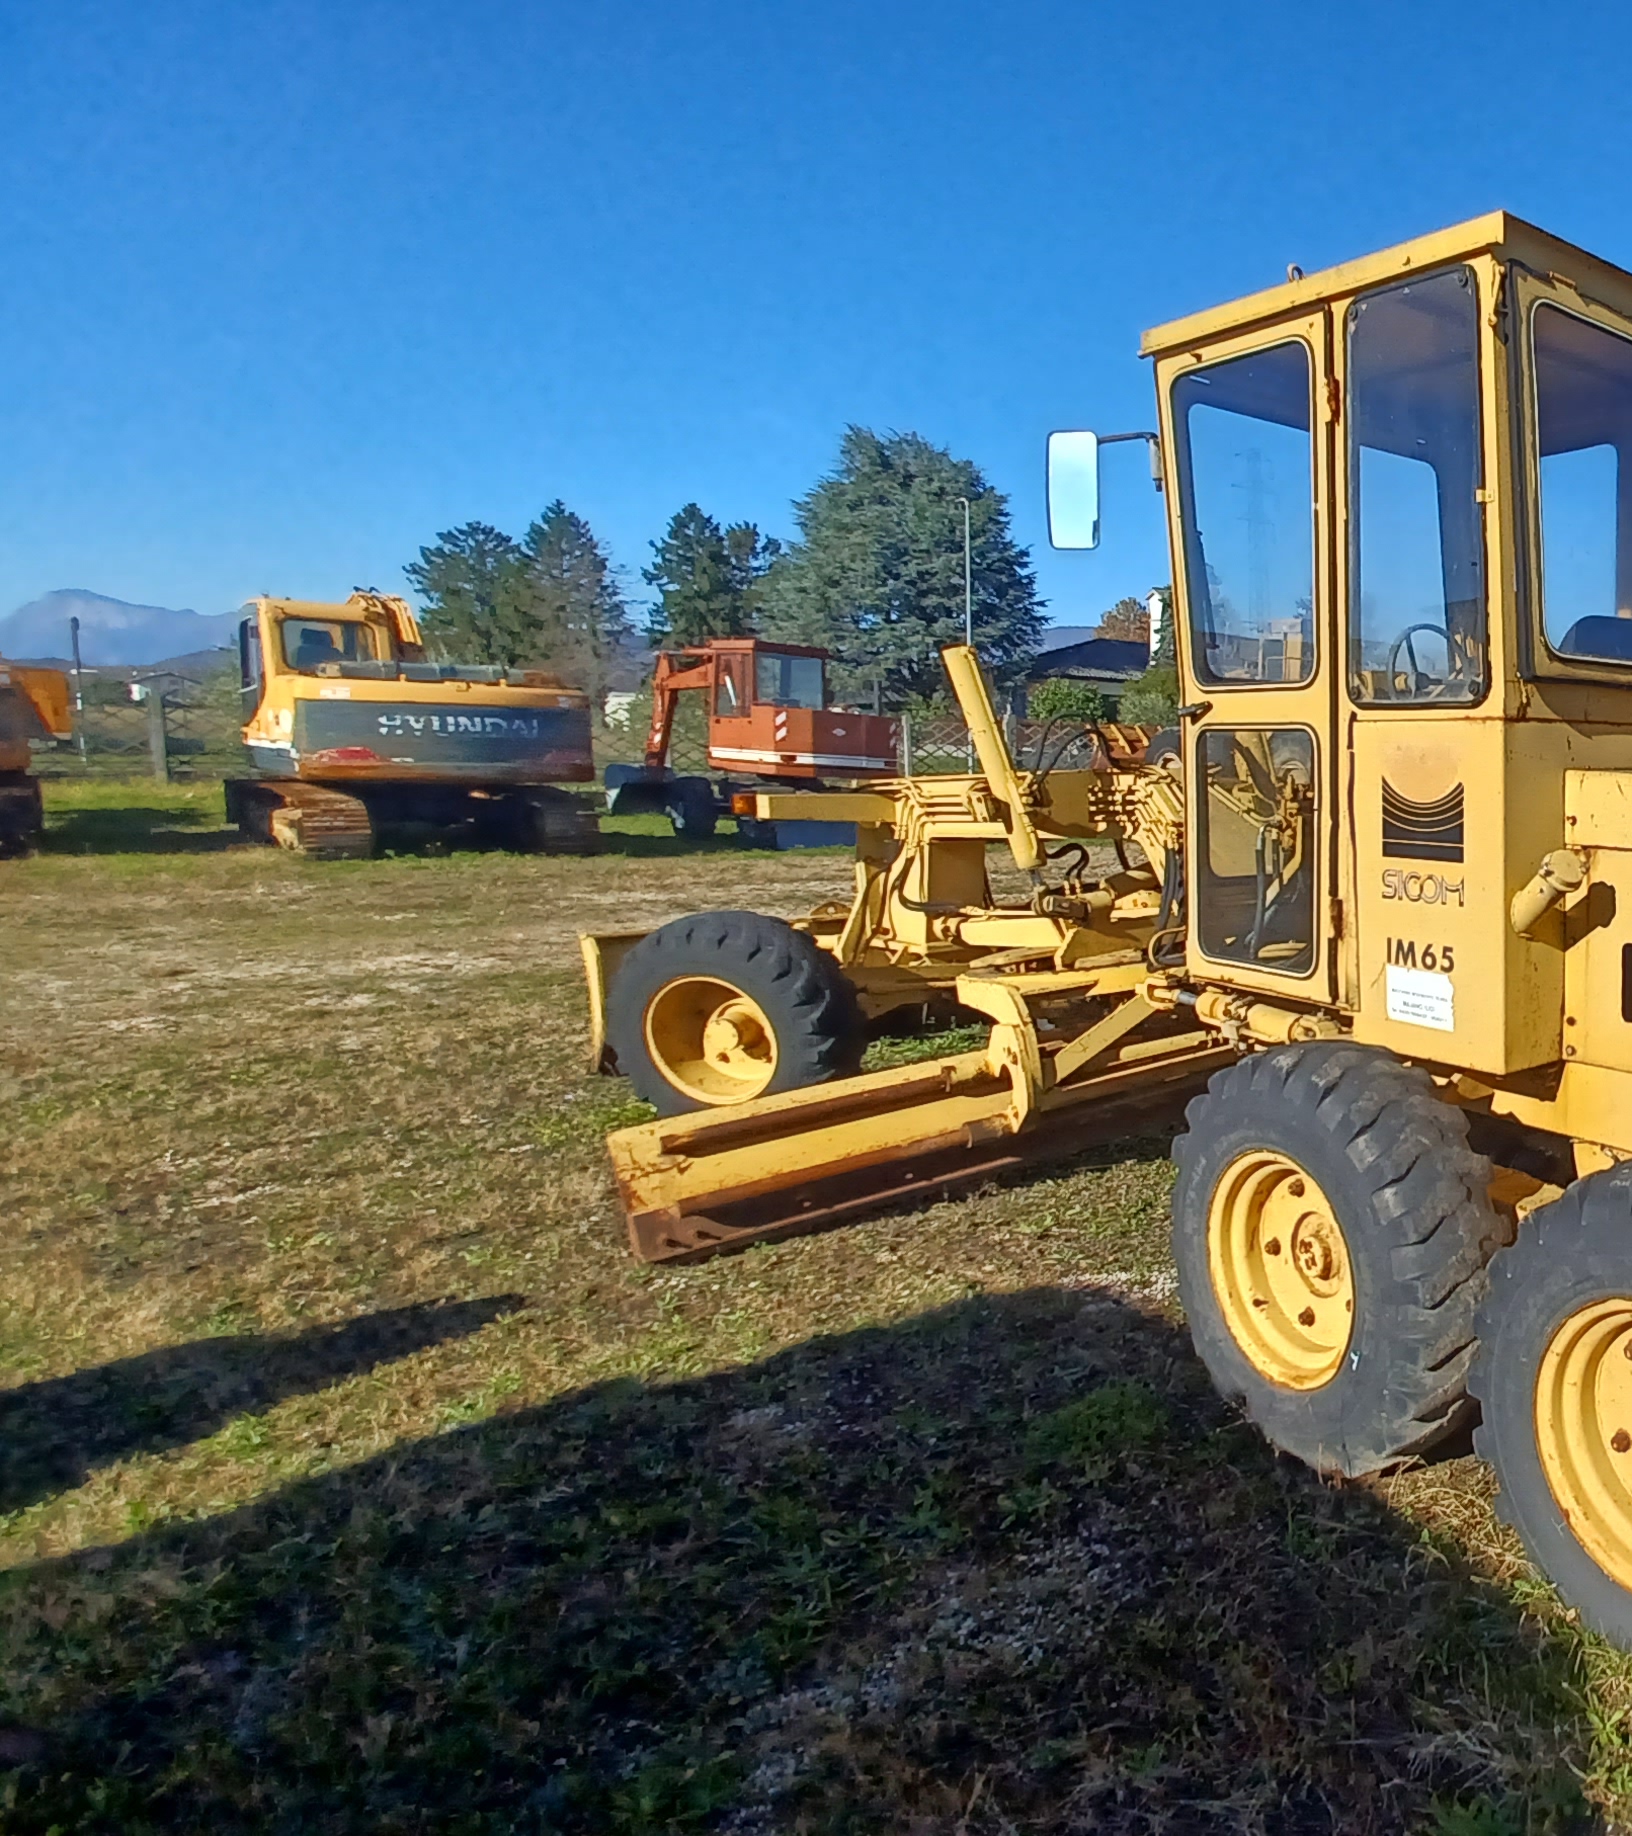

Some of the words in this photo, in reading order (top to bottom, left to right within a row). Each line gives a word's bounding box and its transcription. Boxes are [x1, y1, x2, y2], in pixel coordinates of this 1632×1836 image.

[377, 714, 539, 738] HYUNDAI
[1382, 869, 1464, 907] SICOM
[1387, 937, 1454, 973] IM65
